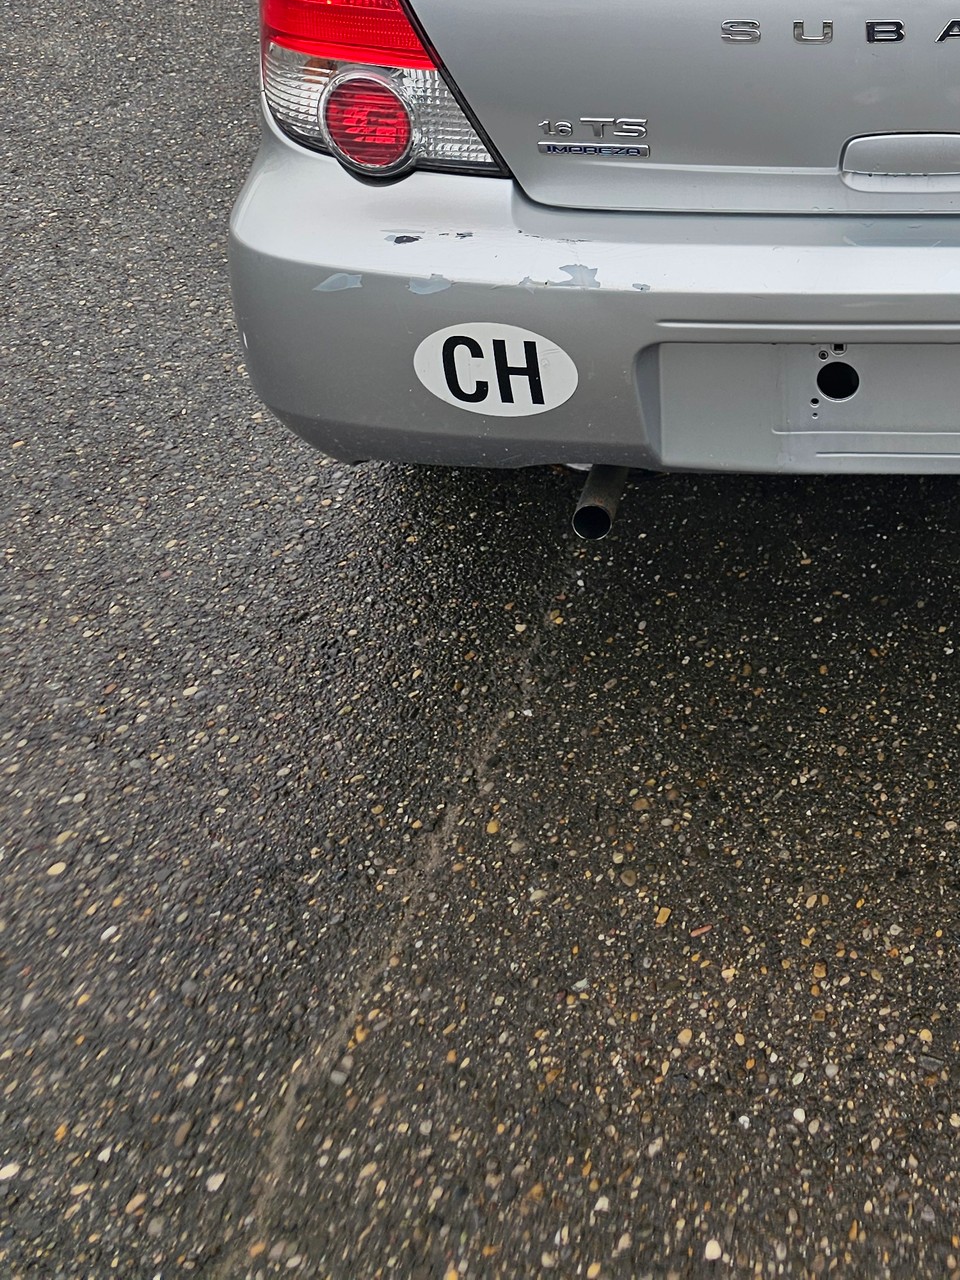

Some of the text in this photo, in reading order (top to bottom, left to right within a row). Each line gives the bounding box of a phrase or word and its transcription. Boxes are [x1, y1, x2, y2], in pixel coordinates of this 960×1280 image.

[579, 117, 648, 138] TS
[546, 144, 641, 157] IMPREZA
[442, 335, 545, 405] CH
